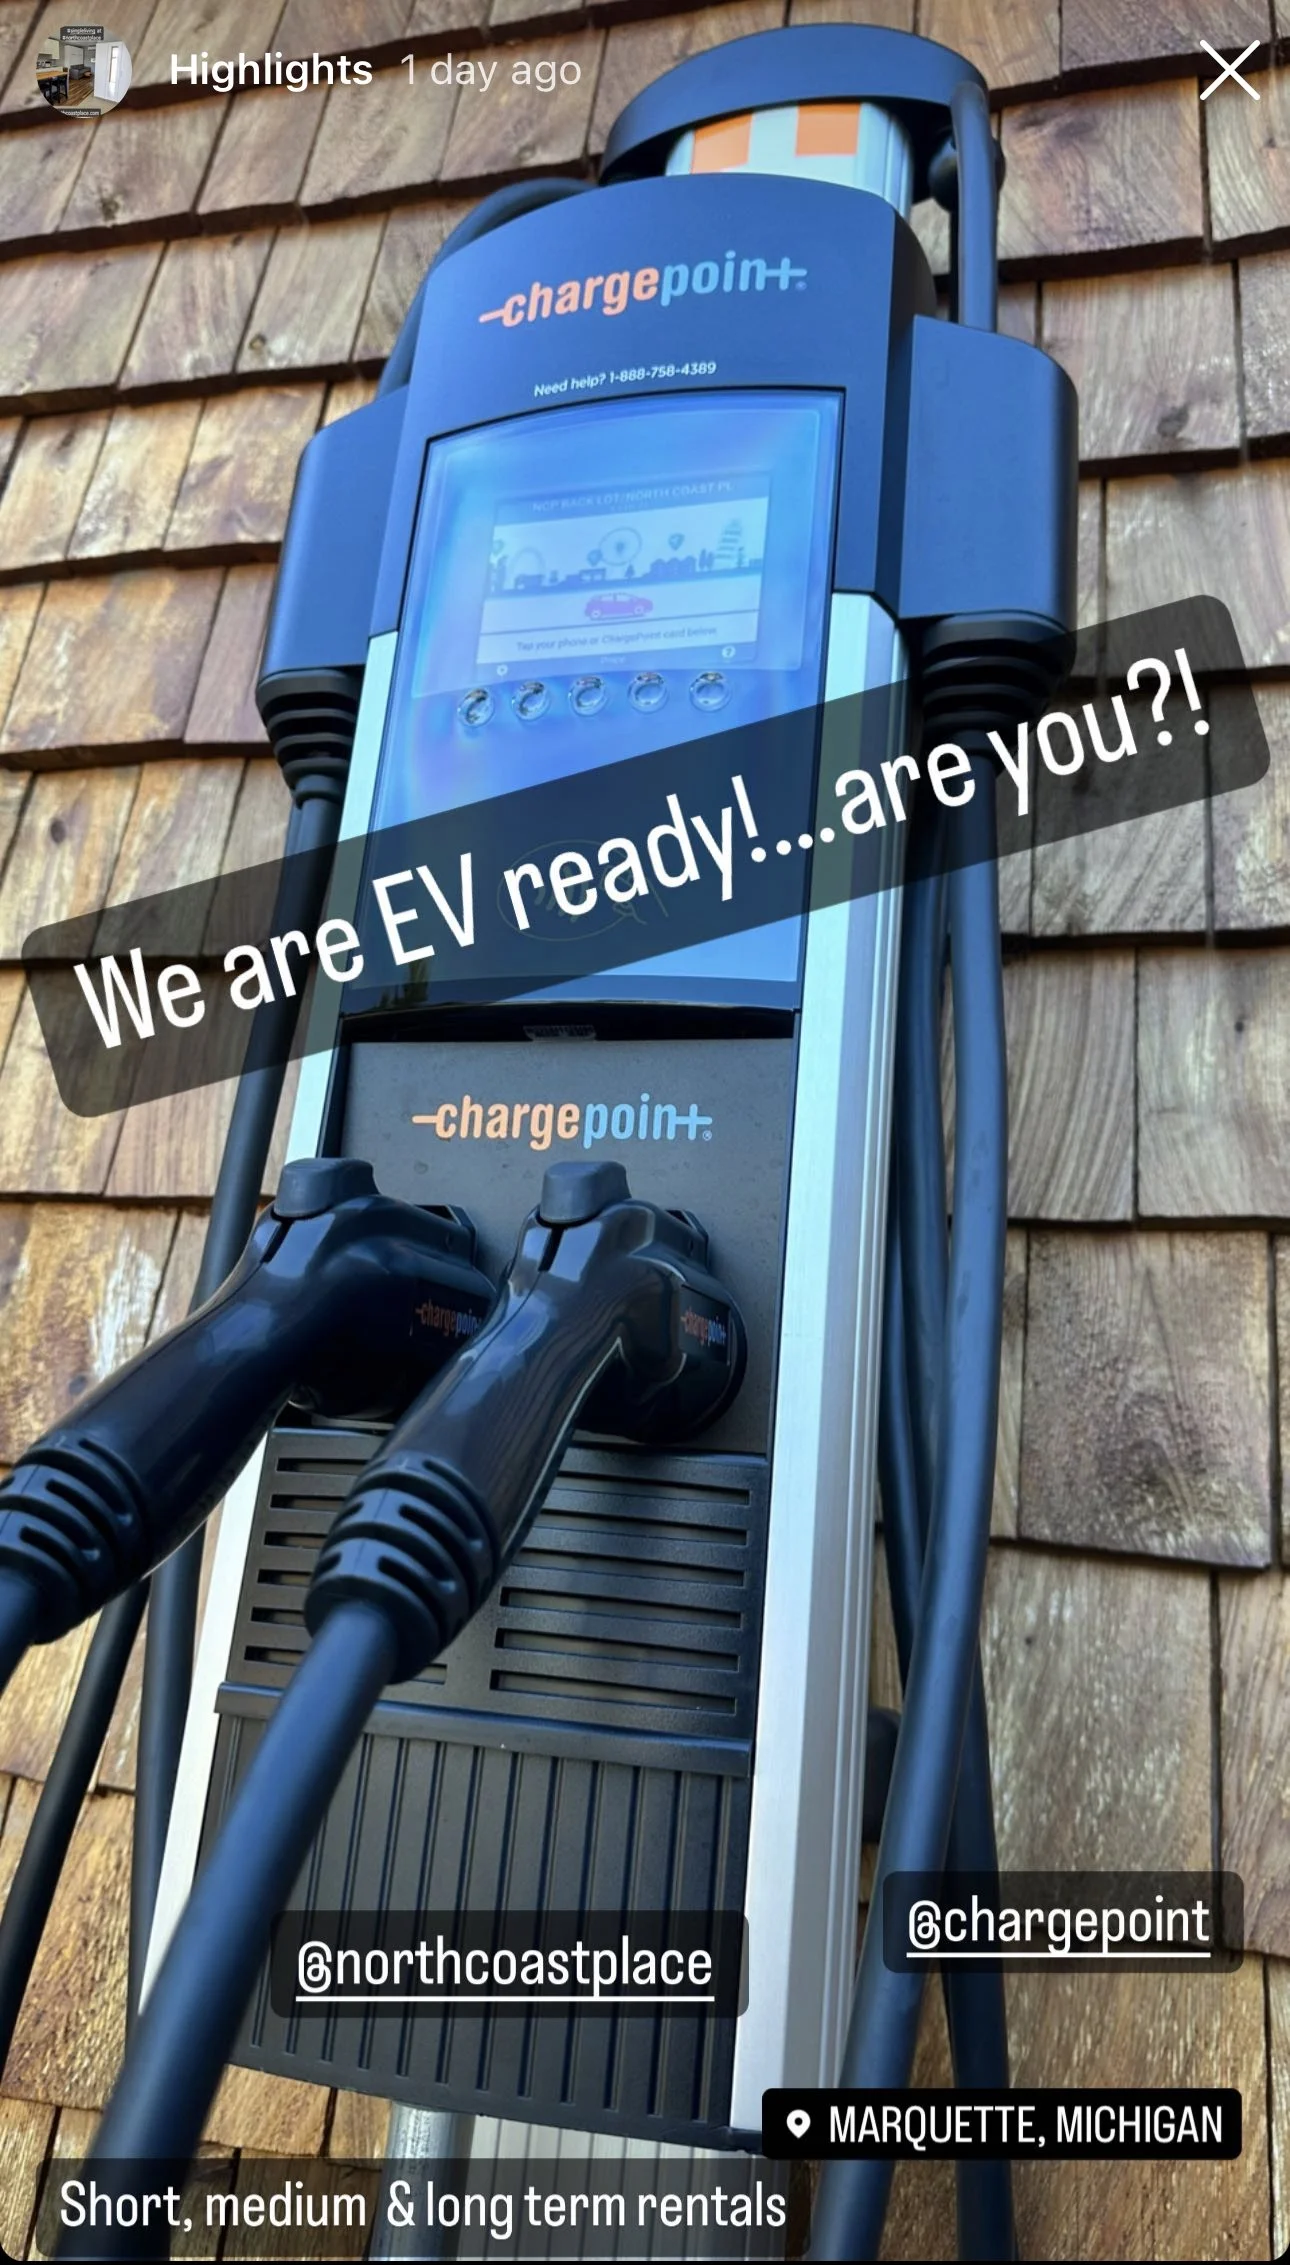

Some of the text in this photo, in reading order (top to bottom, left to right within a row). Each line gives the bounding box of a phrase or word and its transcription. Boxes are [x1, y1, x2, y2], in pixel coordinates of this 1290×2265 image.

[533, 361, 717, 398] Need help? 1-888-758-4389
